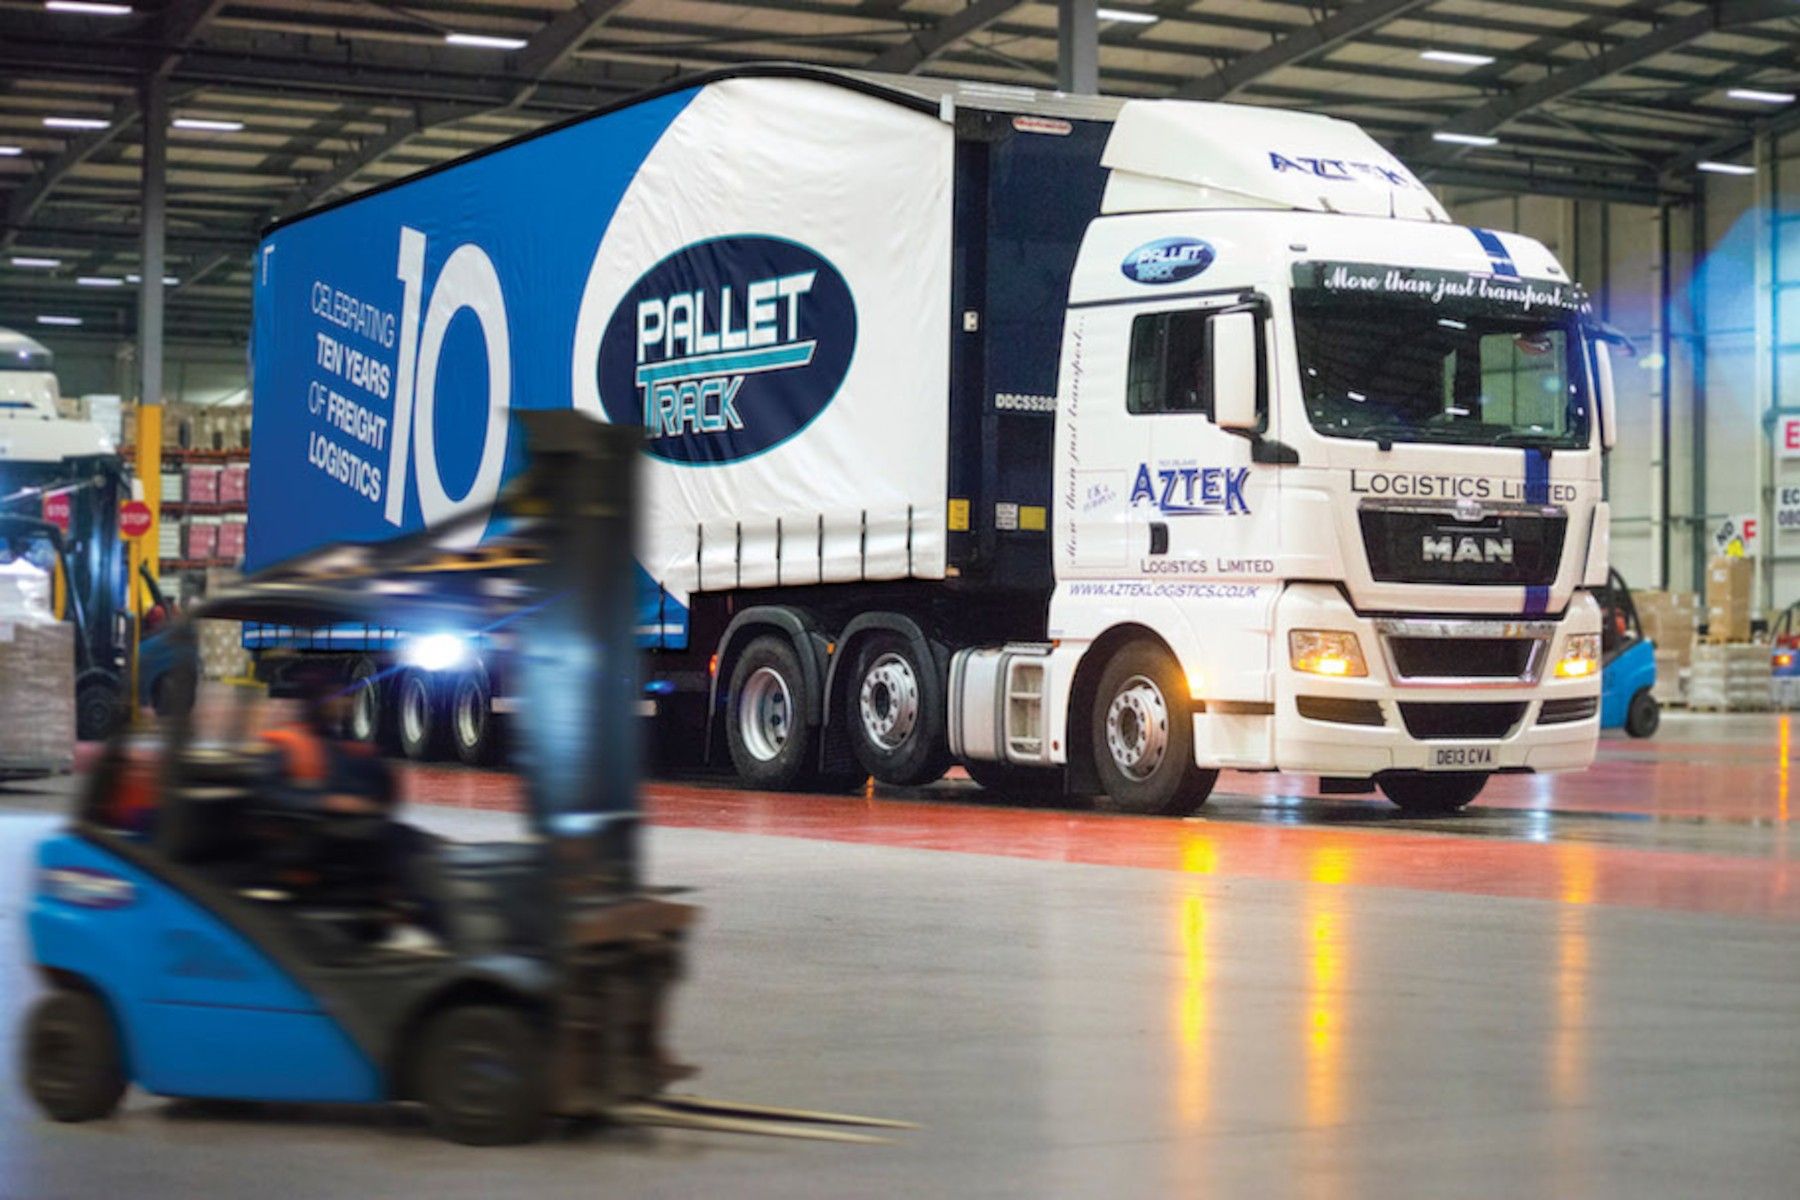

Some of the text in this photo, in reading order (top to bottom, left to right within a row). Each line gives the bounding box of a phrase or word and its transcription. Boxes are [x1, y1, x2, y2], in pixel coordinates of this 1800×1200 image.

[1137, 244, 1205, 266] PALLET
[1324, 266, 1380, 291] More
[1384, 270, 1433, 294] than
[1430, 276, 1476, 304] just
[311, 280, 396, 349] CELEBRATING
[637, 268, 818, 364] PALLET
[316, 332, 391, 400] TEN YEARS
[384, 225, 511, 548] 10
[308, 381, 388, 451] OF FREIGHT
[308, 431, 383, 502] LOGISTICS
[1350, 469, 1491, 498] LOGISTICS
[1130, 463, 1251, 516] AZTEK
[121, 513, 150, 526] STOP
[1140, 557, 1274, 574] LOGISTICS LIMITED
[1422, 535, 1514, 564] MAN
[1437, 748, 1492, 765] DE13 CVA
